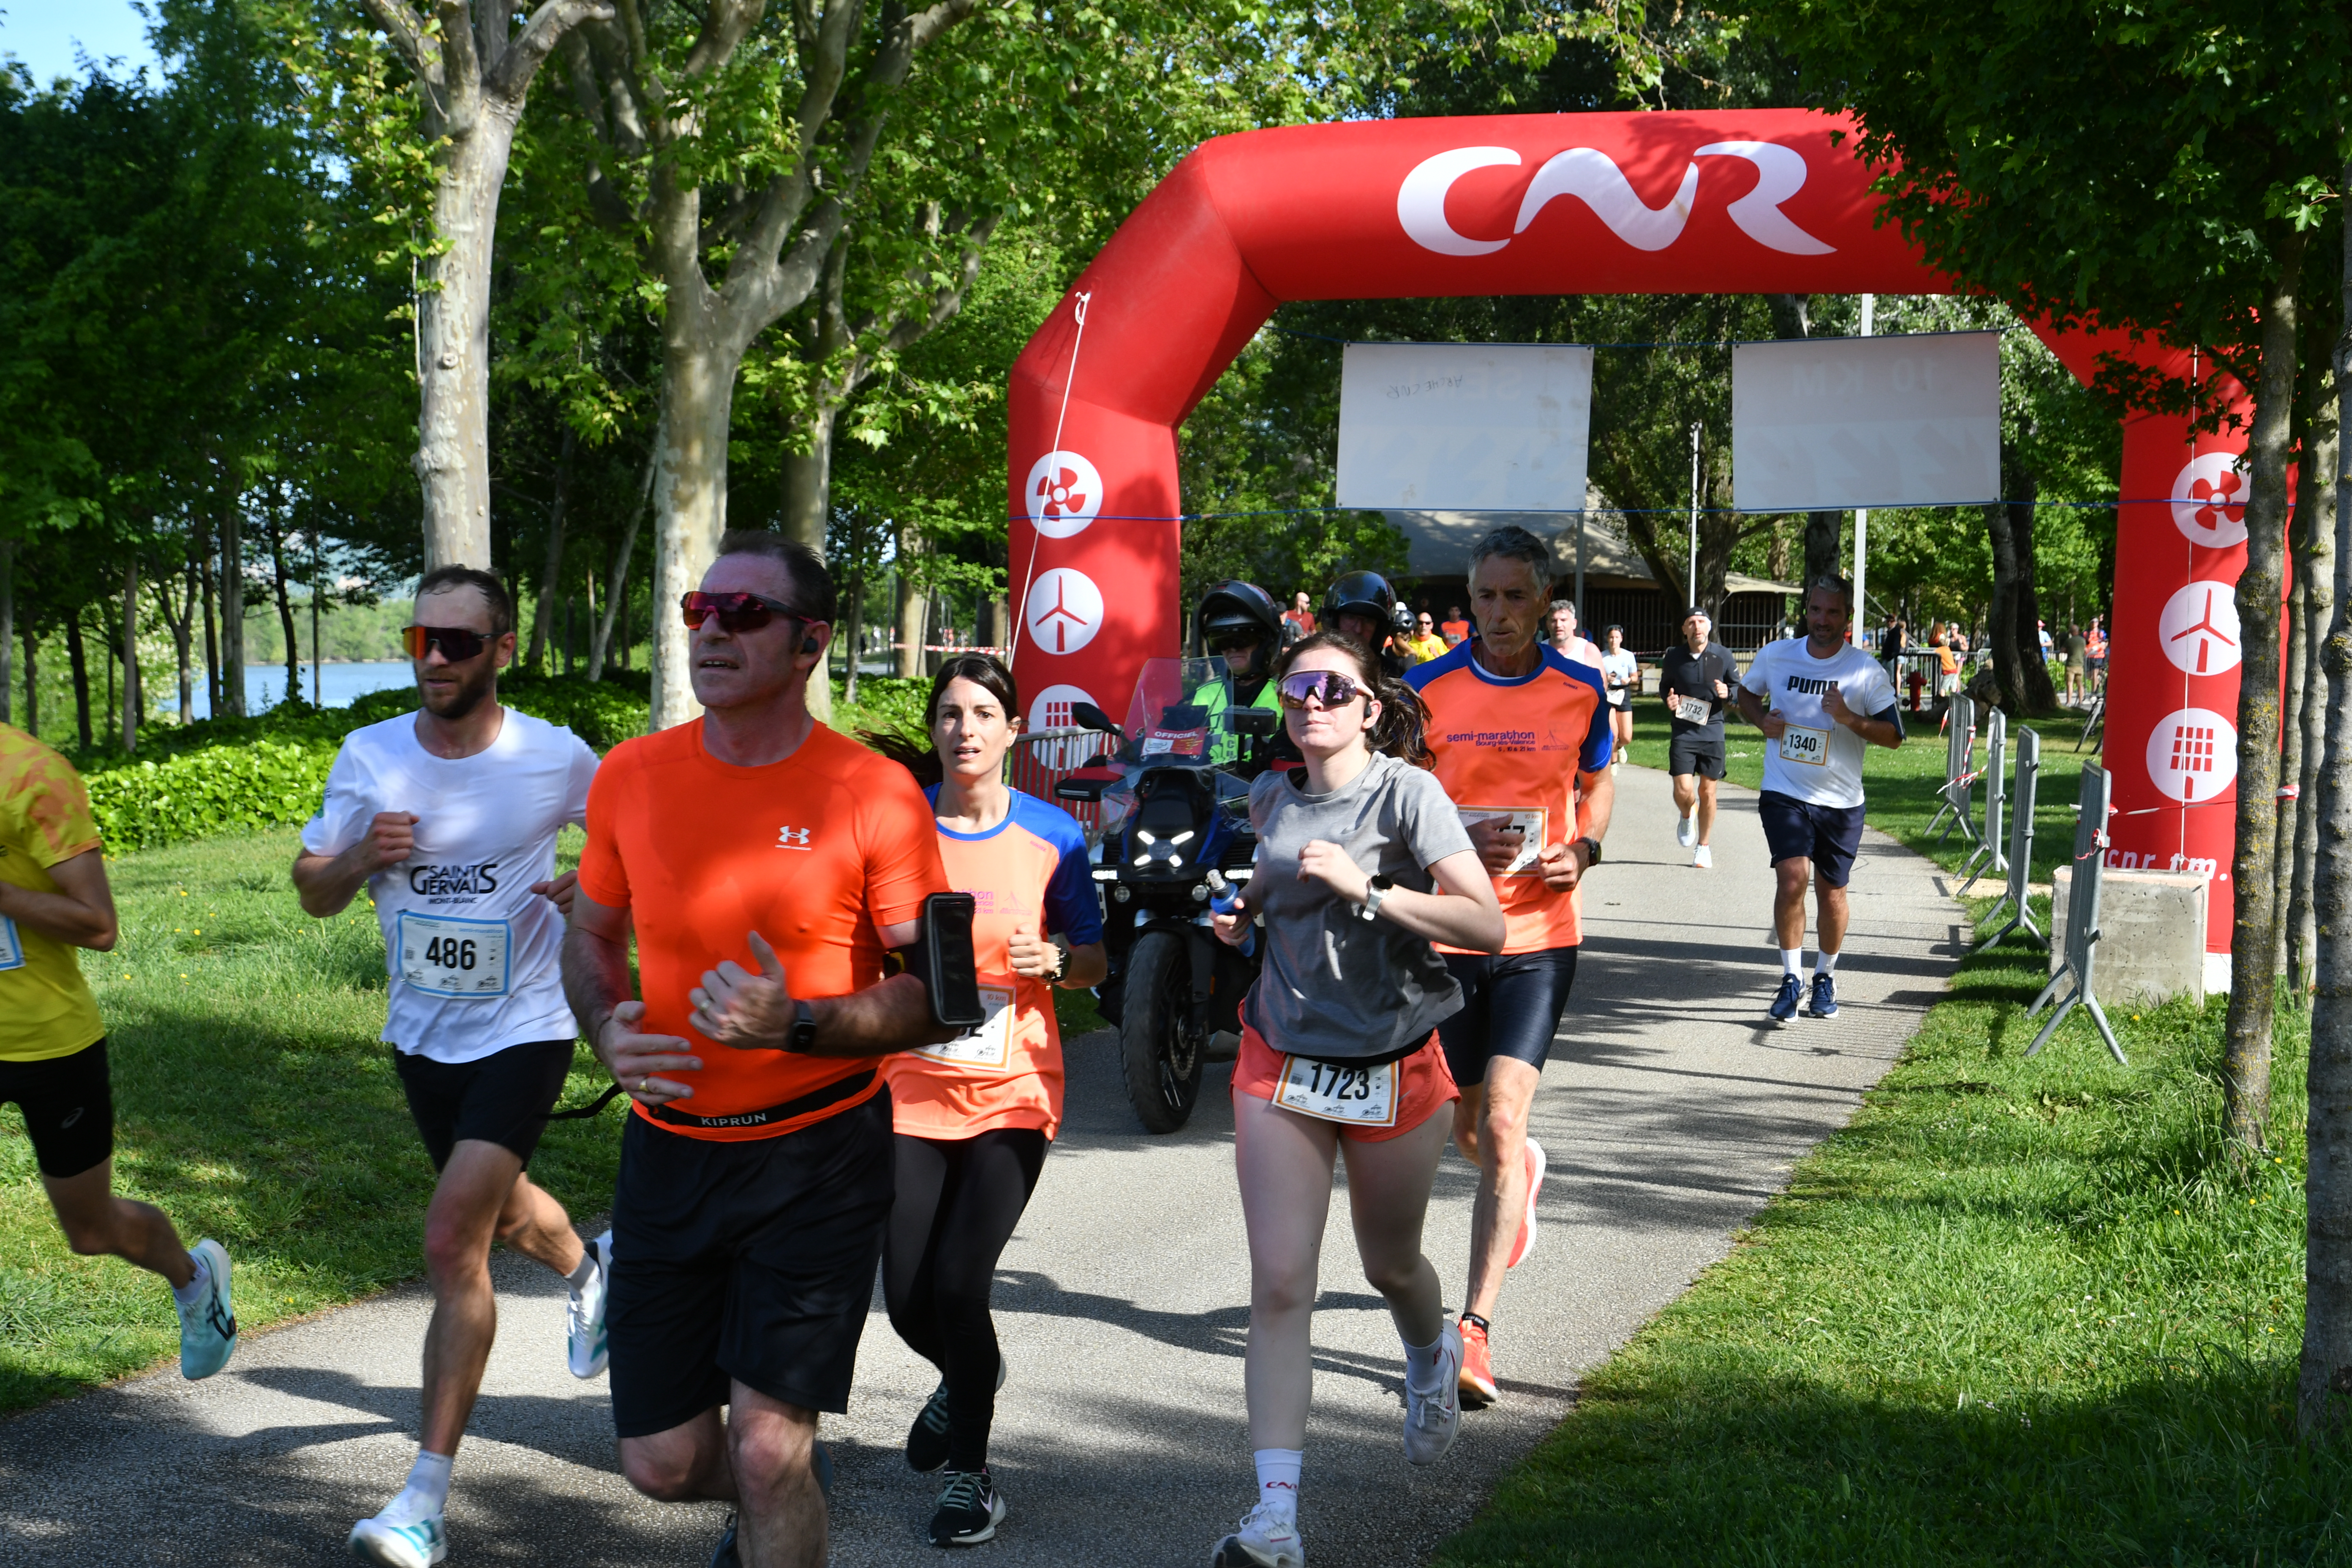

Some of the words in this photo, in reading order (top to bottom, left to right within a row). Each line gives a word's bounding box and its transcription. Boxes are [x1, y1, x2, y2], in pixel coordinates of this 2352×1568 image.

[1397, 140, 1837, 256] CNR
[1685, 702, 1702, 715] 1732
[1154, 731, 1199, 739] OFFICIEL
[1447, 730, 1535, 742] semi-marathon
[1789, 733, 1817, 752] 1340
[426, 936, 477, 970] 486
[1310, 1063, 1369, 1100] 1723
[701, 1112, 767, 1127] KIPRUN
